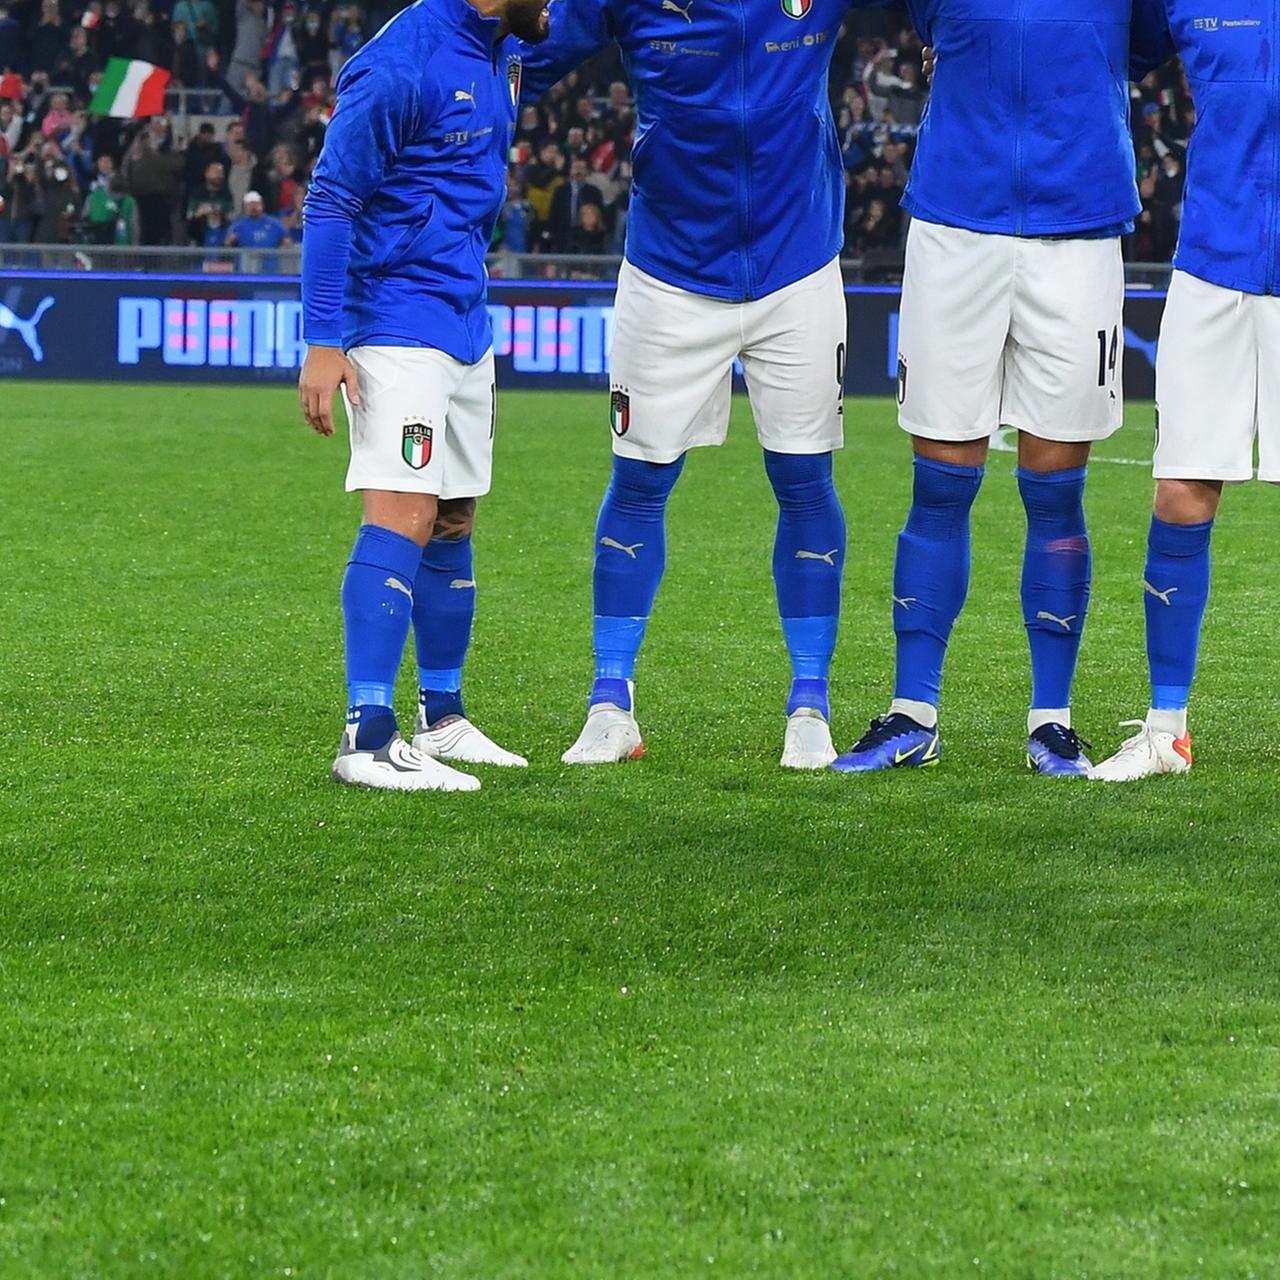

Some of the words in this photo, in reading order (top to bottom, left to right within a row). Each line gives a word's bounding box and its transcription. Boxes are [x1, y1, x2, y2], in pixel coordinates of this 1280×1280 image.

[1204, 18, 1218, 27] TV
[780, 39, 800, 51] eni
[118, 297, 306, 368] PUMA
[486, 304, 614, 373] PUM
[1097, 324, 1118, 386] 14
[404, 426, 432, 436] ITALIA
